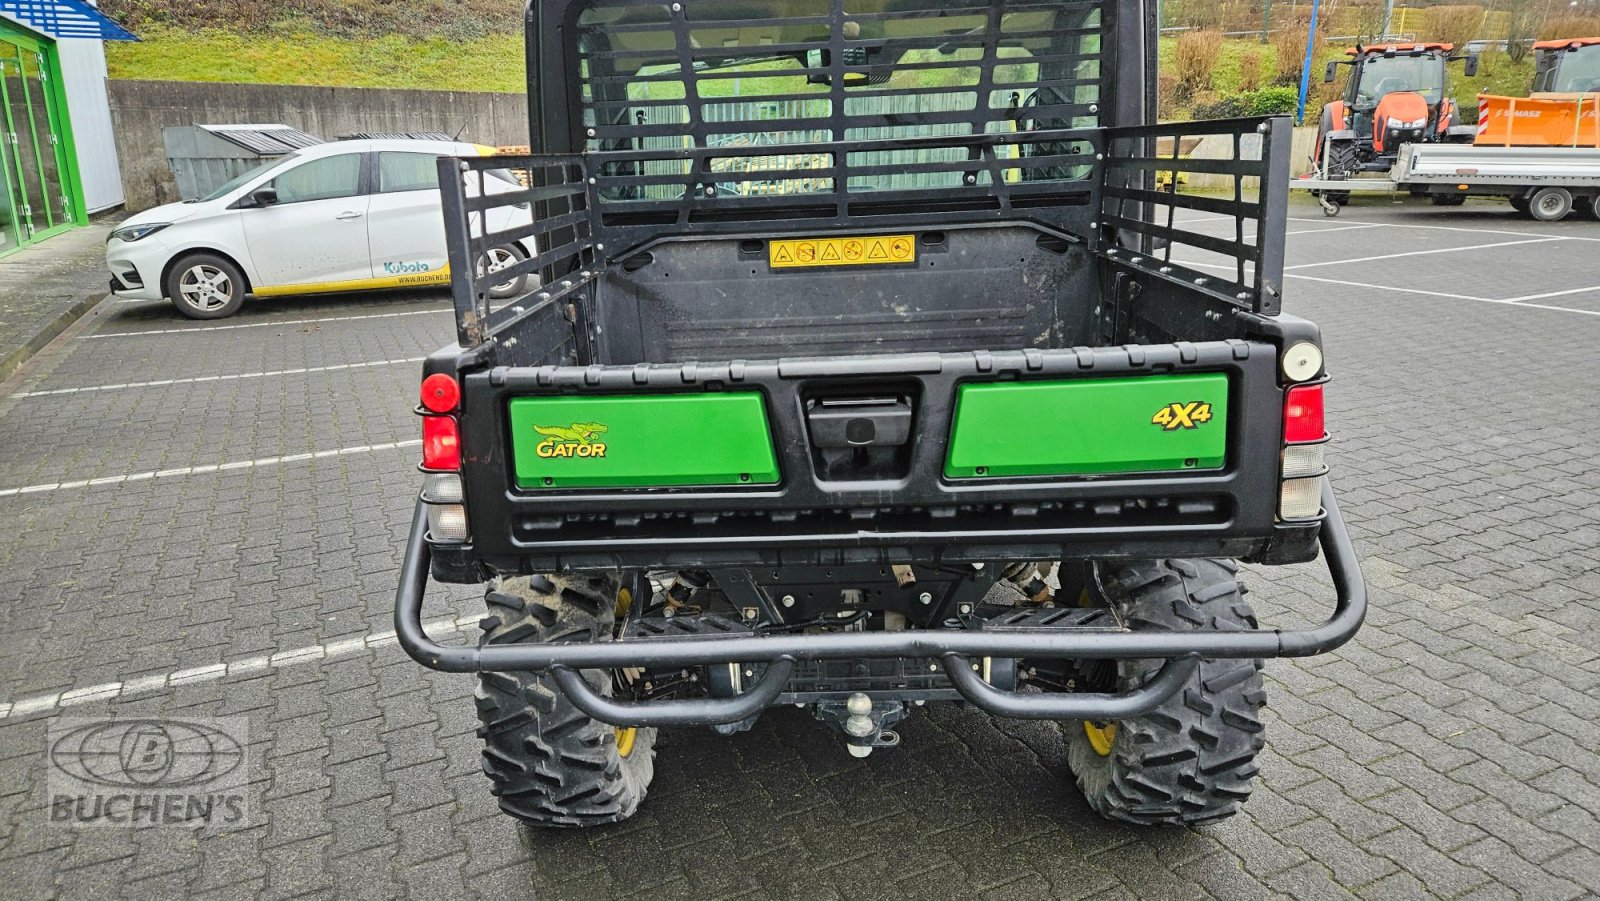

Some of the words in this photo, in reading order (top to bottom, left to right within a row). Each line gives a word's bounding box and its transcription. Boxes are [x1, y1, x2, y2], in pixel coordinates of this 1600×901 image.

[1504, 110, 1542, 118] SMASZ
[384, 261, 429, 273] Kubota
[1152, 402, 1212, 429] 4X4
[536, 440, 606, 457] GATOR
